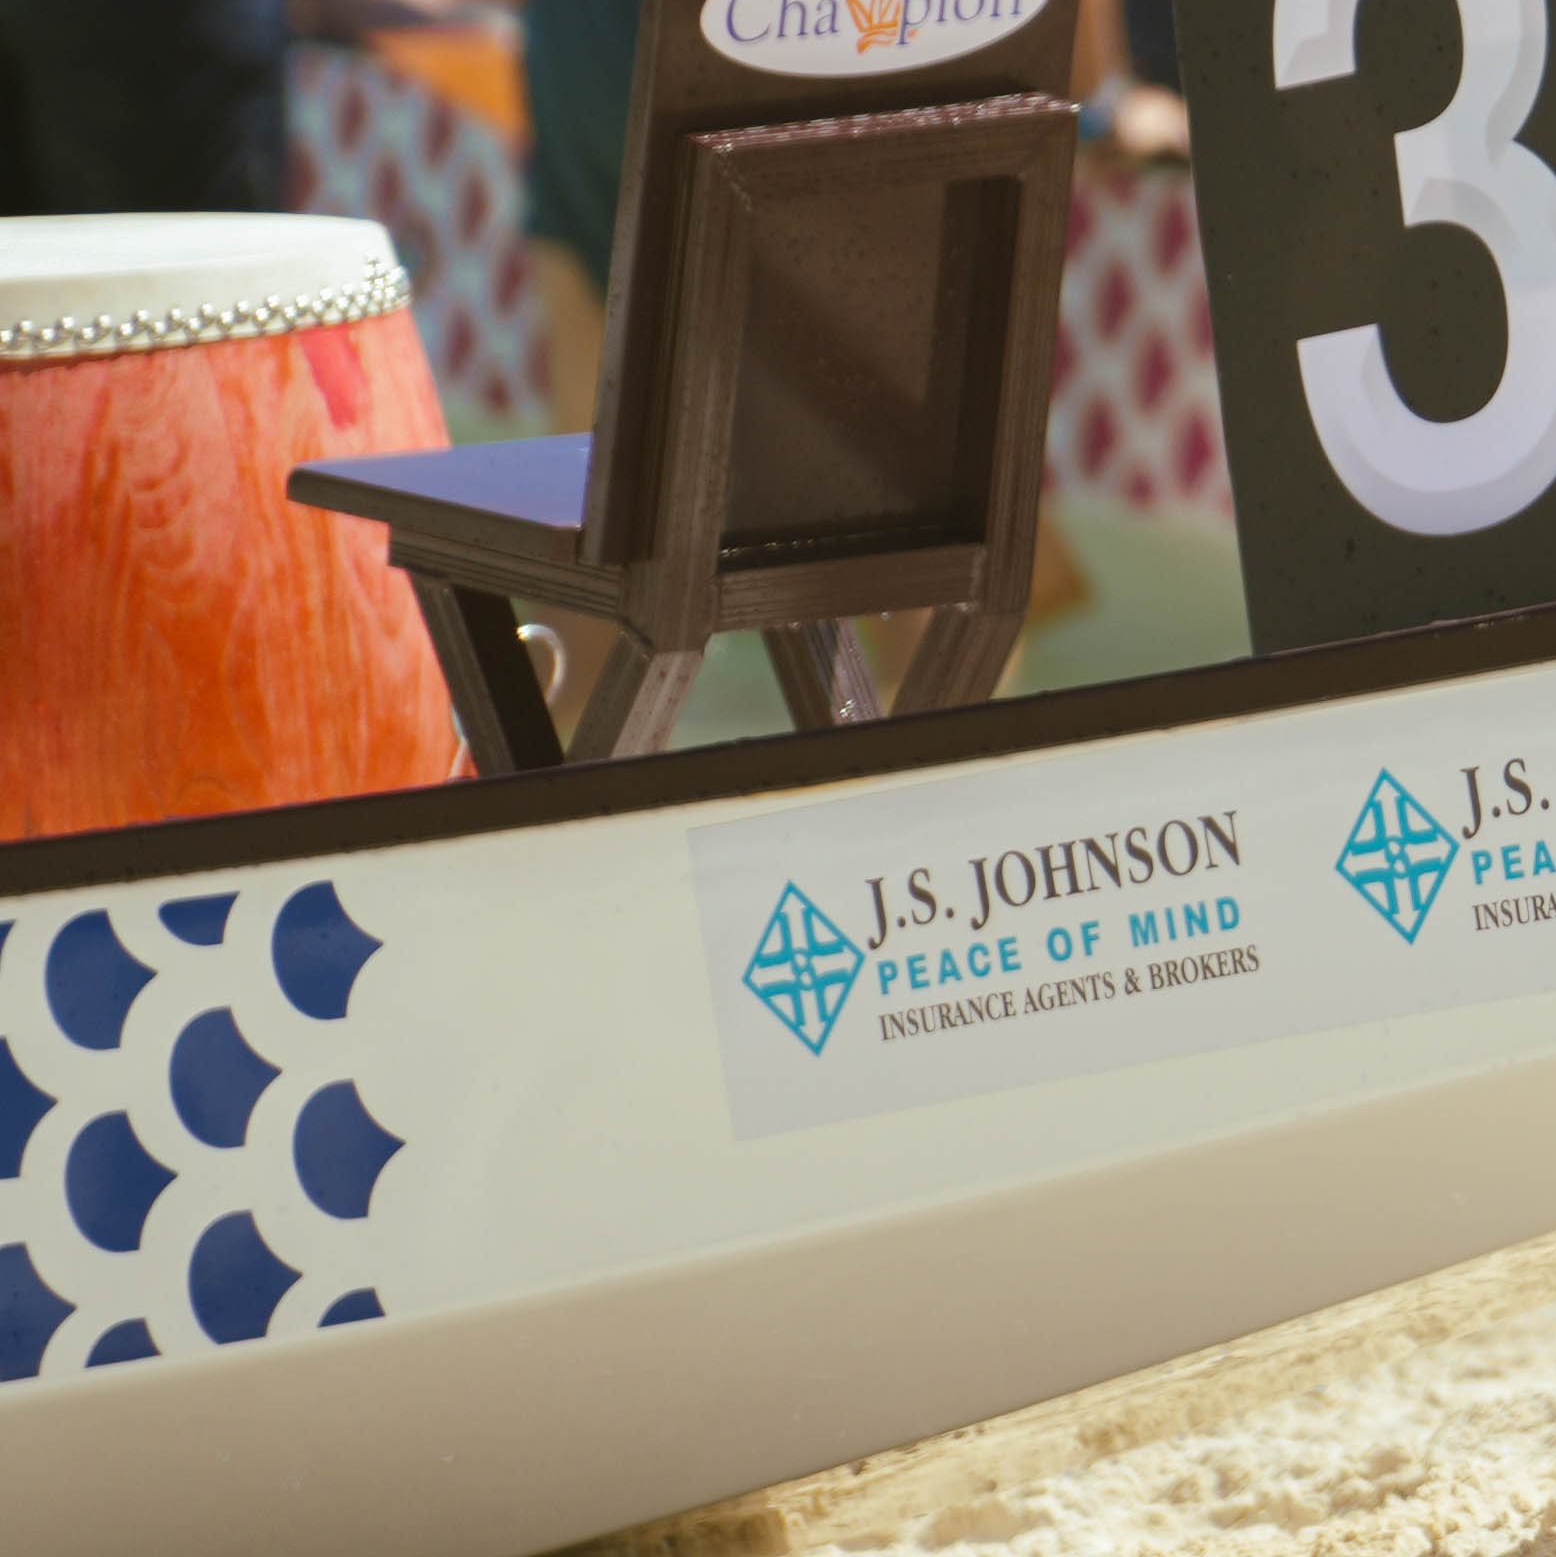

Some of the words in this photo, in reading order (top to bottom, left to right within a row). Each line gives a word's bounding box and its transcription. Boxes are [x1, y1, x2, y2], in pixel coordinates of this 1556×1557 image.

[1459, 758, 1550, 840] J.S.
[865, 867, 955, 950] J.S.
[968, 810, 1242, 931] JOHNSON
[877, 936, 1022, 995] PEACE
[1046, 920, 1101, 962] OF
[1129, 896, 1241, 948] MIND
[878, 990, 1017, 1042] INSURANCE
[1023, 971, 1116, 1014] AGENTS
[1124, 967, 1142, 994] &
[1147, 944, 1261, 990] BROKERS
